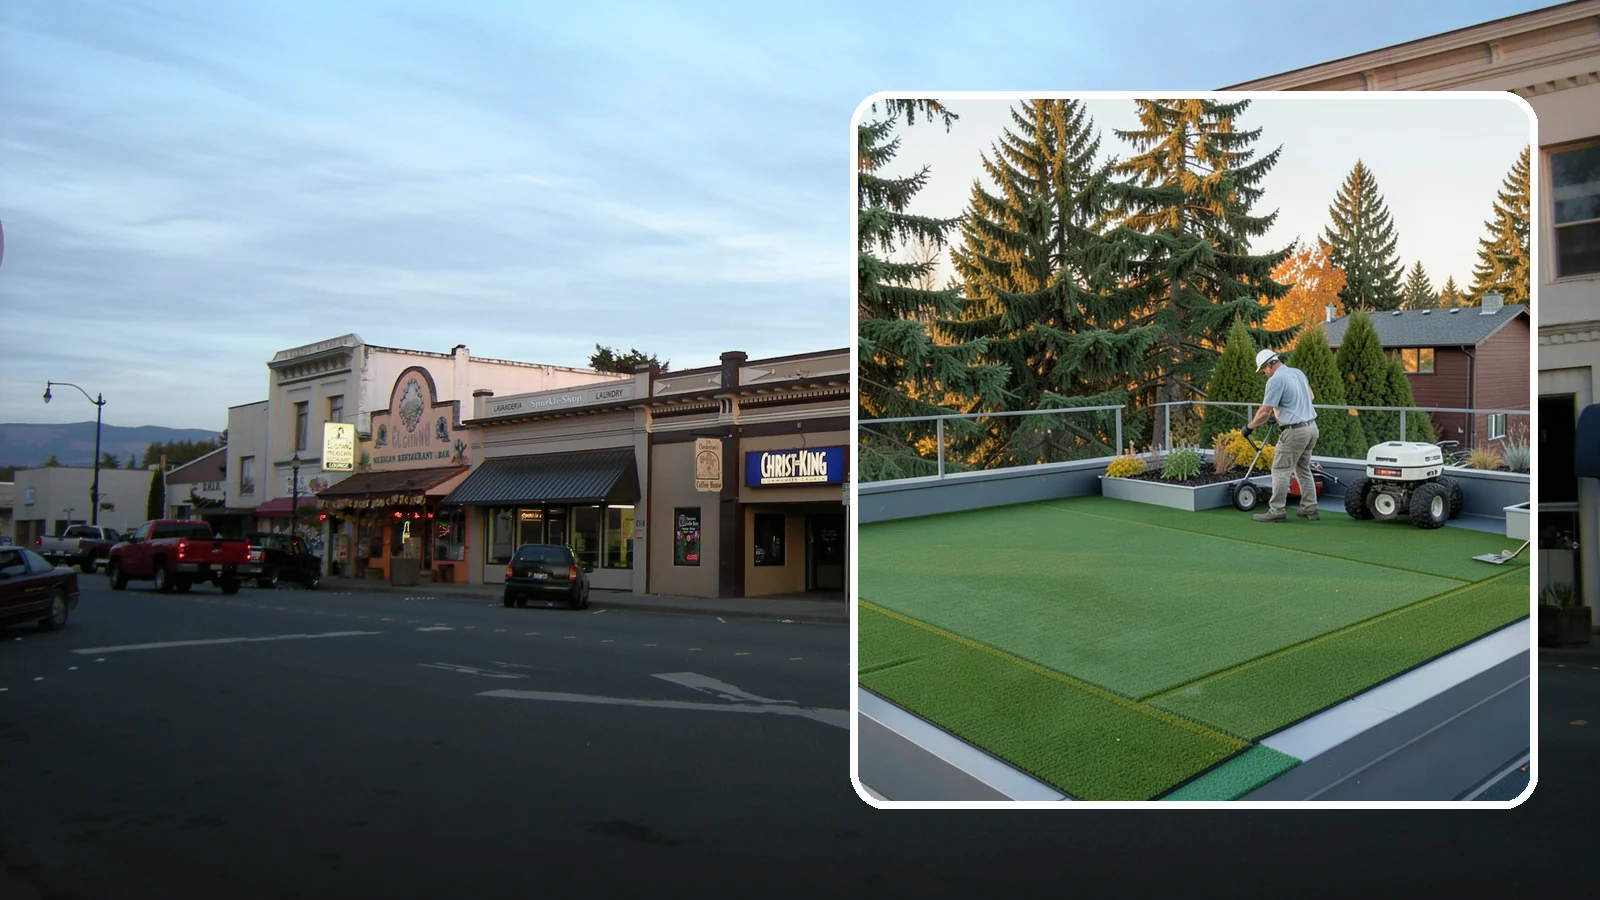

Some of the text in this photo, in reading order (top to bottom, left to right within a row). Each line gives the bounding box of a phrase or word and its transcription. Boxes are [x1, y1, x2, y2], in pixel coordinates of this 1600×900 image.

[530, 394, 583, 409] Sparkle Shop
[595, 389, 623, 400] LAUNDRY
[493, 402, 522, 412] LAVANDERIA
[374, 454, 396, 464] MEXICAN
[398, 451, 433, 463] RESTAURANT
[438, 450, 450, 459] BAR
[761, 450, 827, 478] CHRIST KING
